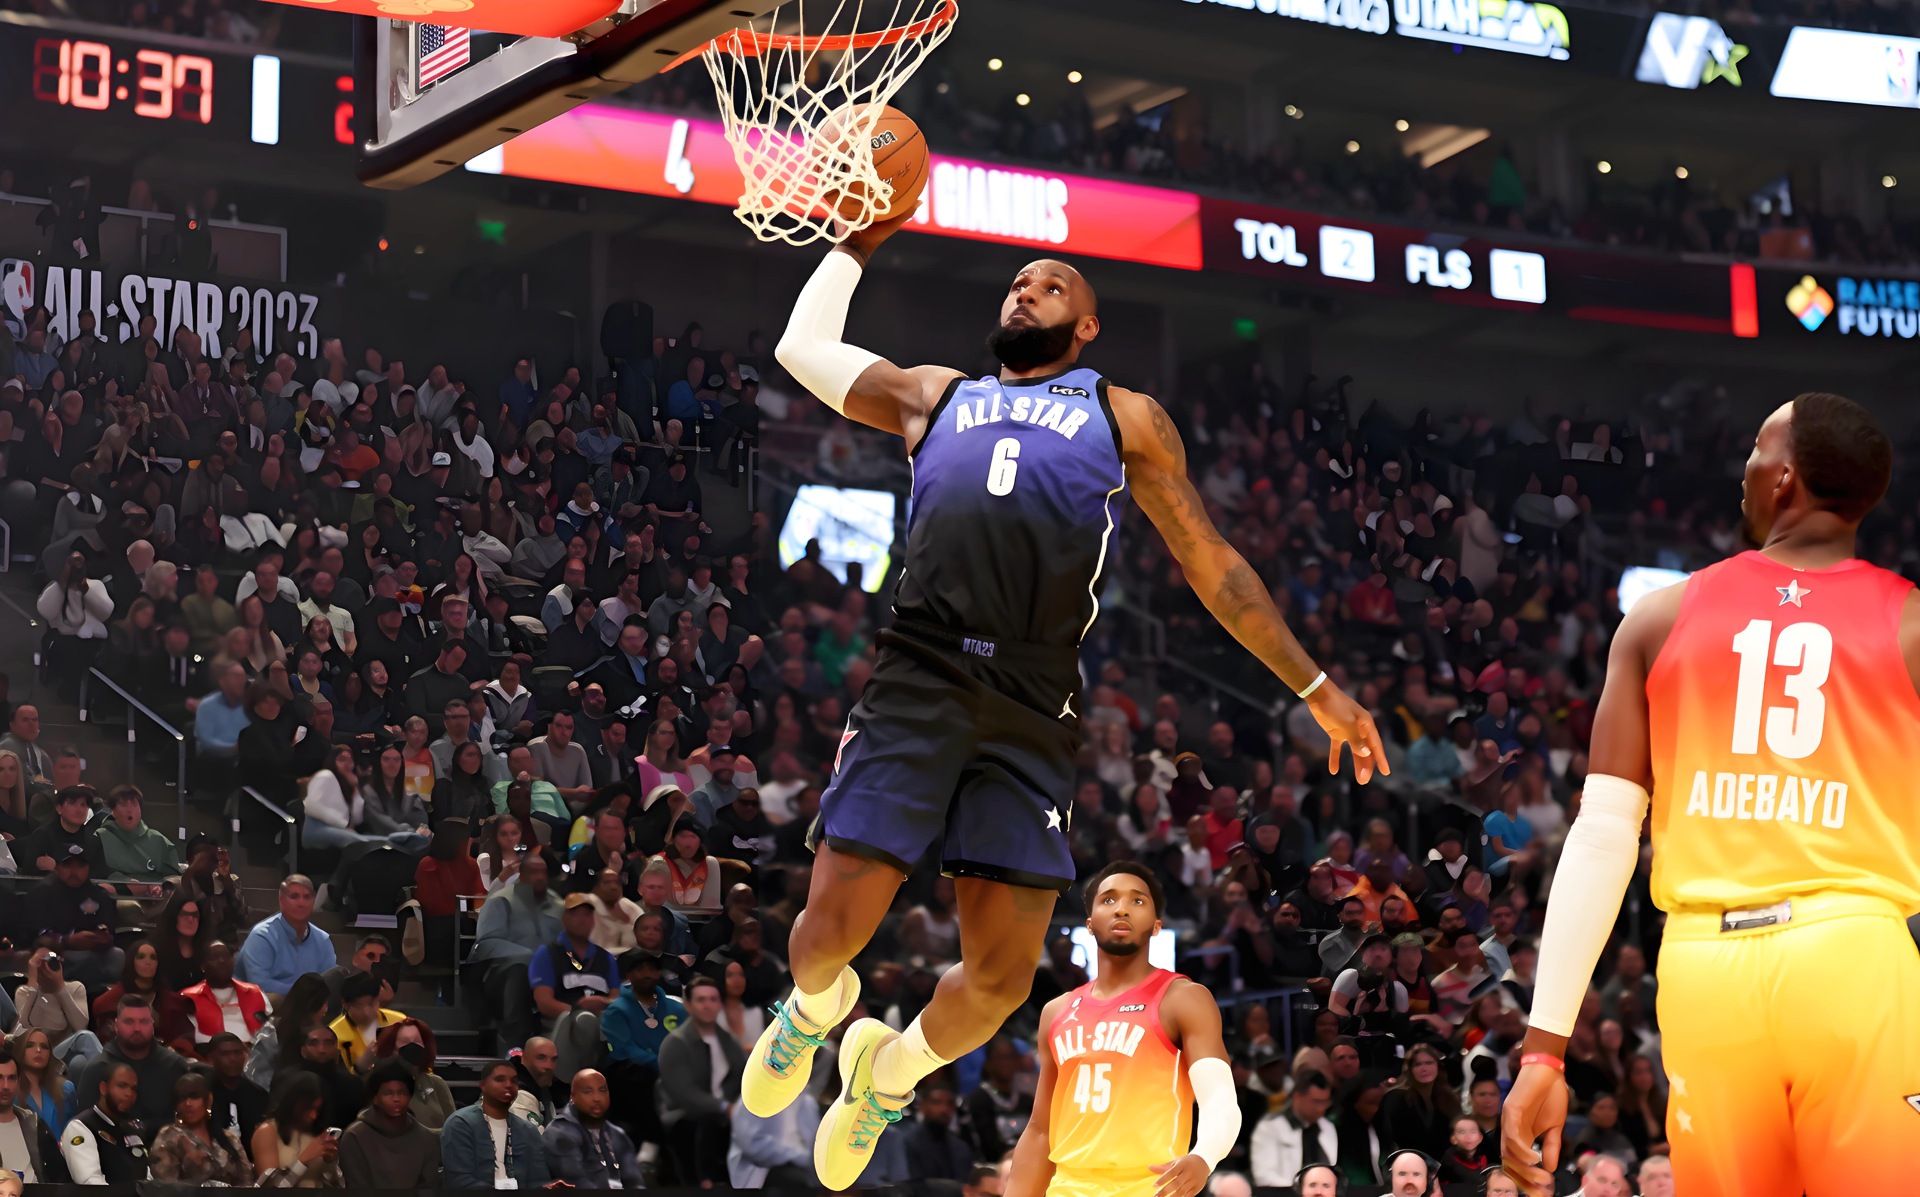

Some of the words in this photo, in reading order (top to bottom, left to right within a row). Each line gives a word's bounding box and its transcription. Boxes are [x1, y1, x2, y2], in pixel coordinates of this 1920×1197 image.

[58, 39, 213, 125] 10:37
[664, 119, 695, 194] 4
[933, 162, 1069, 244] GIANNIS
[1233, 218, 1308, 268] TOL
[1405, 243, 1473, 290] FLS
[1838, 304, 1920, 339] FUTU
[986, 437, 1021, 497] 6
[1731, 618, 1833, 760] 13
[1686, 770, 1849, 830] ADEBAYO
[1073, 1062, 1113, 1114] 45
